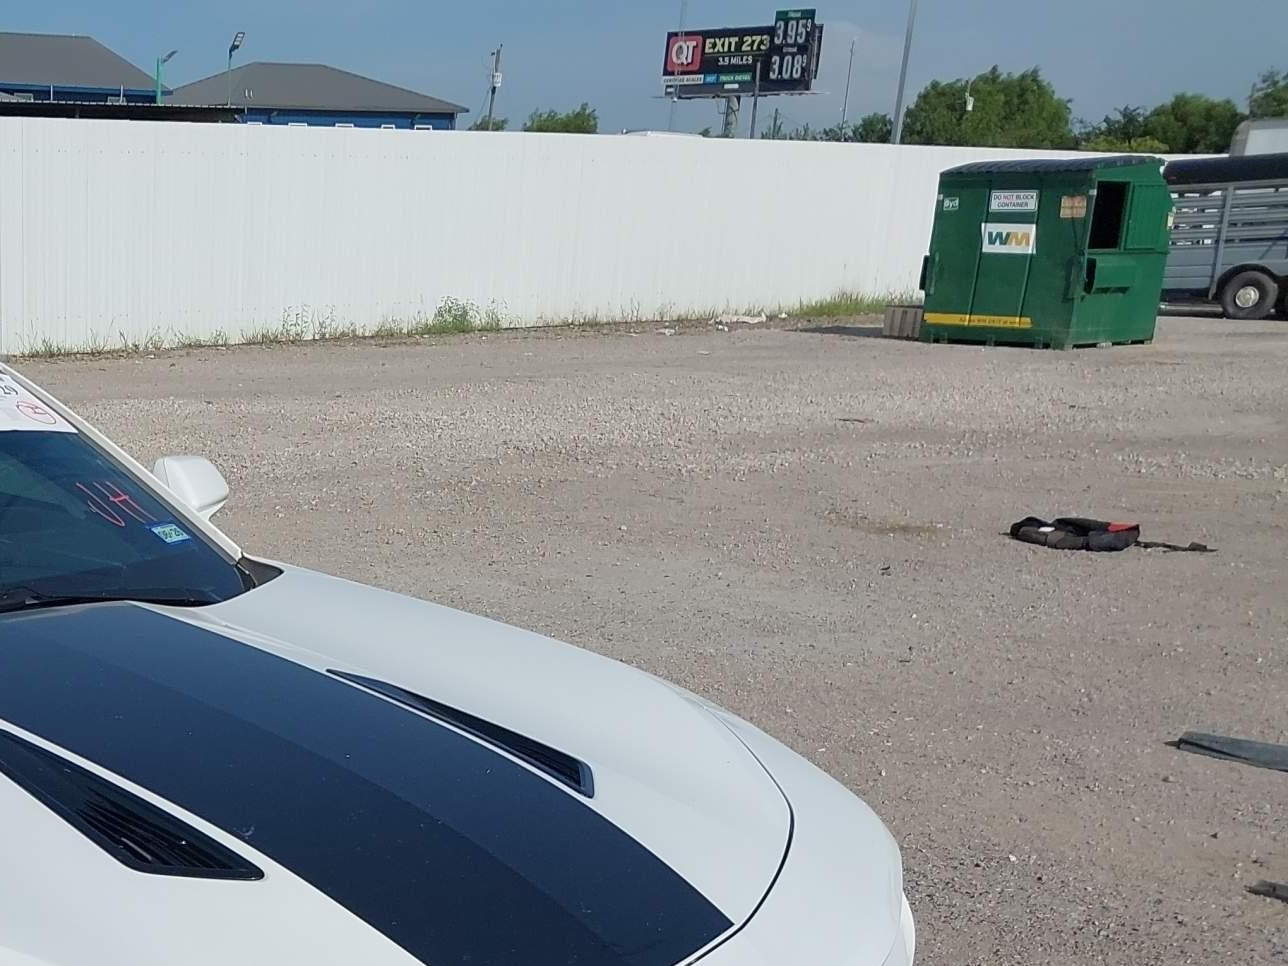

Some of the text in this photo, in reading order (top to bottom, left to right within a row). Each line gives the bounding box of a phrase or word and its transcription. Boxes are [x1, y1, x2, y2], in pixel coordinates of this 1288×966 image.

[705, 35, 770, 53] EXIT 273
[672, 41, 697, 65] QT
[730, 55, 753, 65] MILES
[988, 231, 1030, 246] WM
